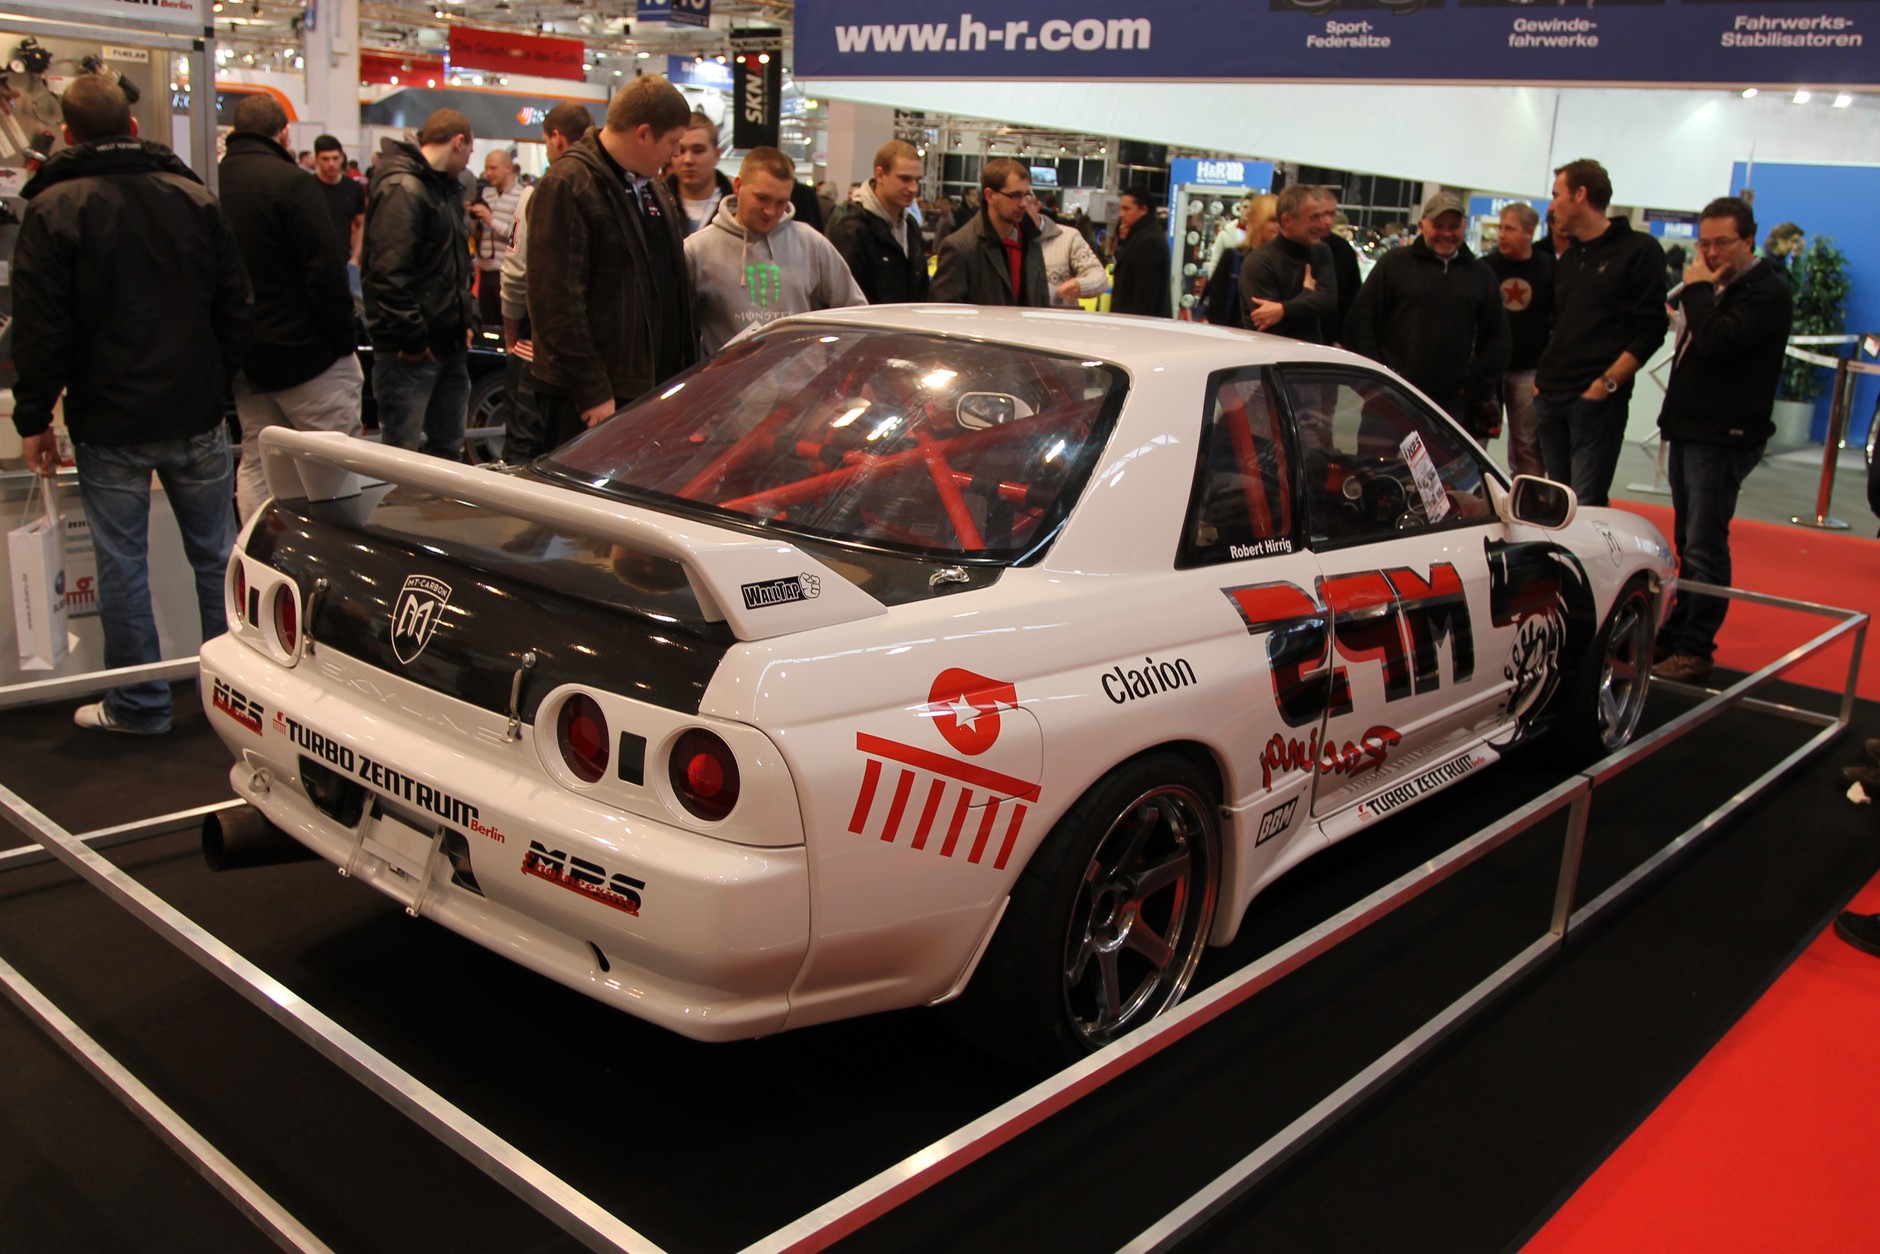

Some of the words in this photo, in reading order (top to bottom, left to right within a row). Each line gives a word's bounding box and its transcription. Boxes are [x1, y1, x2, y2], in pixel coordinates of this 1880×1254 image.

[161, 0, 193, 10] Berlin
[835, 14, 1151, 52] www.h-r.com
[1326, 21, 1373, 34] Sport-
[1513, 18, 1597, 33] Gewinde-
[1734, 14, 1854, 30] Fahrwerks-
[1307, 35, 1391, 48] Federsätze
[1508, 33, 1599, 48] fahrwerke
[1721, 31, 1863, 47] Stabilisatoren
[745, 74, 763, 125] SKN
[1229, 541, 1264, 559] Robert
[1264, 537, 1292, 553] Hirrig
[407, 579, 448, 597] MT-CARBON
[213, 677, 264, 726] MPS
[286, 717, 354, 773] TURBO
[358, 754, 480, 828] ZENTRUM
[1366, 783, 1418, 816] TURBO
[1413, 754, 1474, 794] ZENTRUM
[470, 818, 505, 844] Berlin
[1260, 800, 1298, 843] BBM
[521, 852, 638, 915] Engineering
[528, 840, 646, 912] MPS
